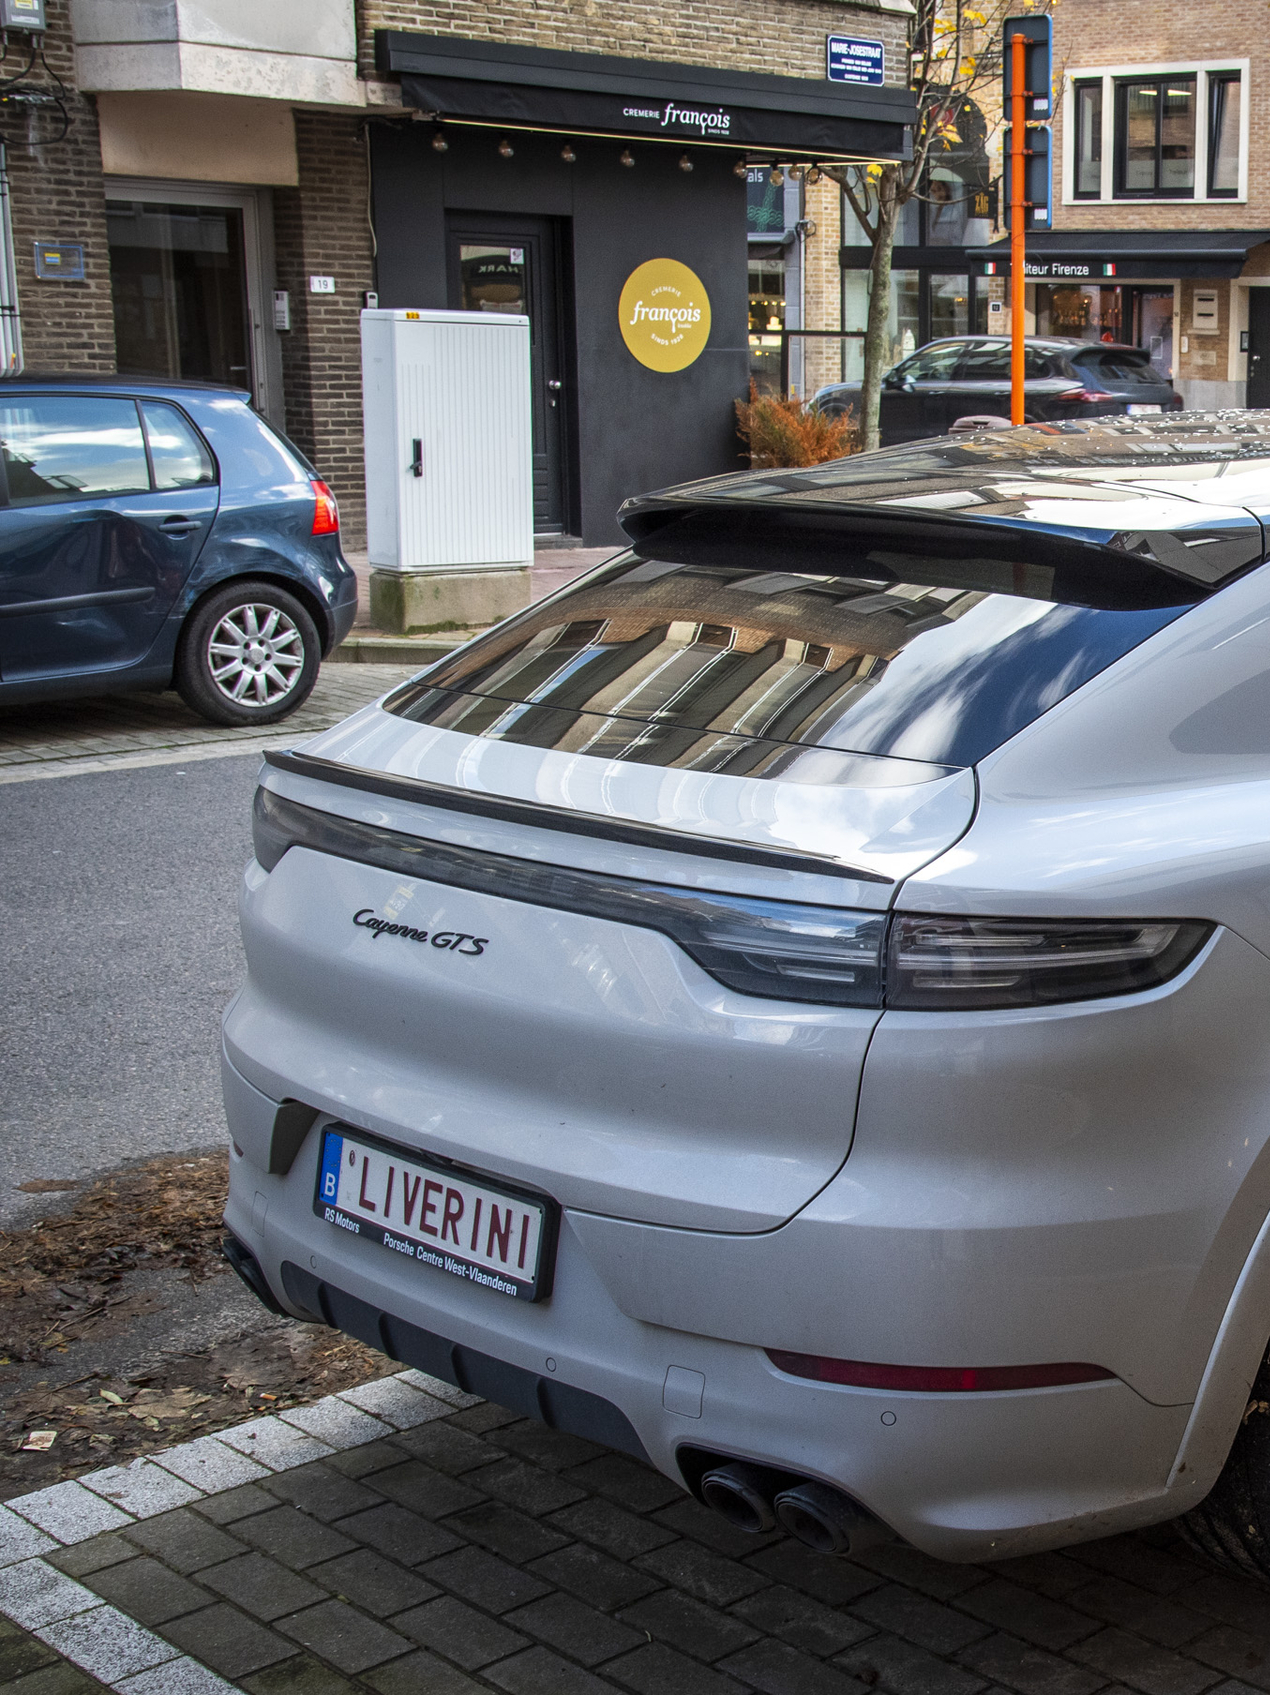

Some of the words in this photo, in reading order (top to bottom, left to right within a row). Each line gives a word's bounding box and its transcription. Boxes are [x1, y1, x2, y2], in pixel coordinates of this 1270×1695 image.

[623, 108, 660, 119] CREMERIE
[661, 102, 730, 135] françois
[1052, 263, 1089, 275] Firenze
[317, 279, 328, 290] 19
[651, 286, 681, 298] CREMERIE
[630, 300, 701, 333] françois
[651, 333, 669, 346] SINDS
[353, 908, 428, 942] Cayenne
[431, 931, 489, 955] GTS
[324, 1172, 336, 1197] B
[324, 1208, 335, 1222] RS
[335, 1211, 360, 1234] Motors
[359, 1156, 530, 1269] LIVERINI
[383, 1233, 414, 1256] Porsche
[416, 1245, 443, 1268] Centre
[444, 1256, 517, 1297] West-Vlaanderen
